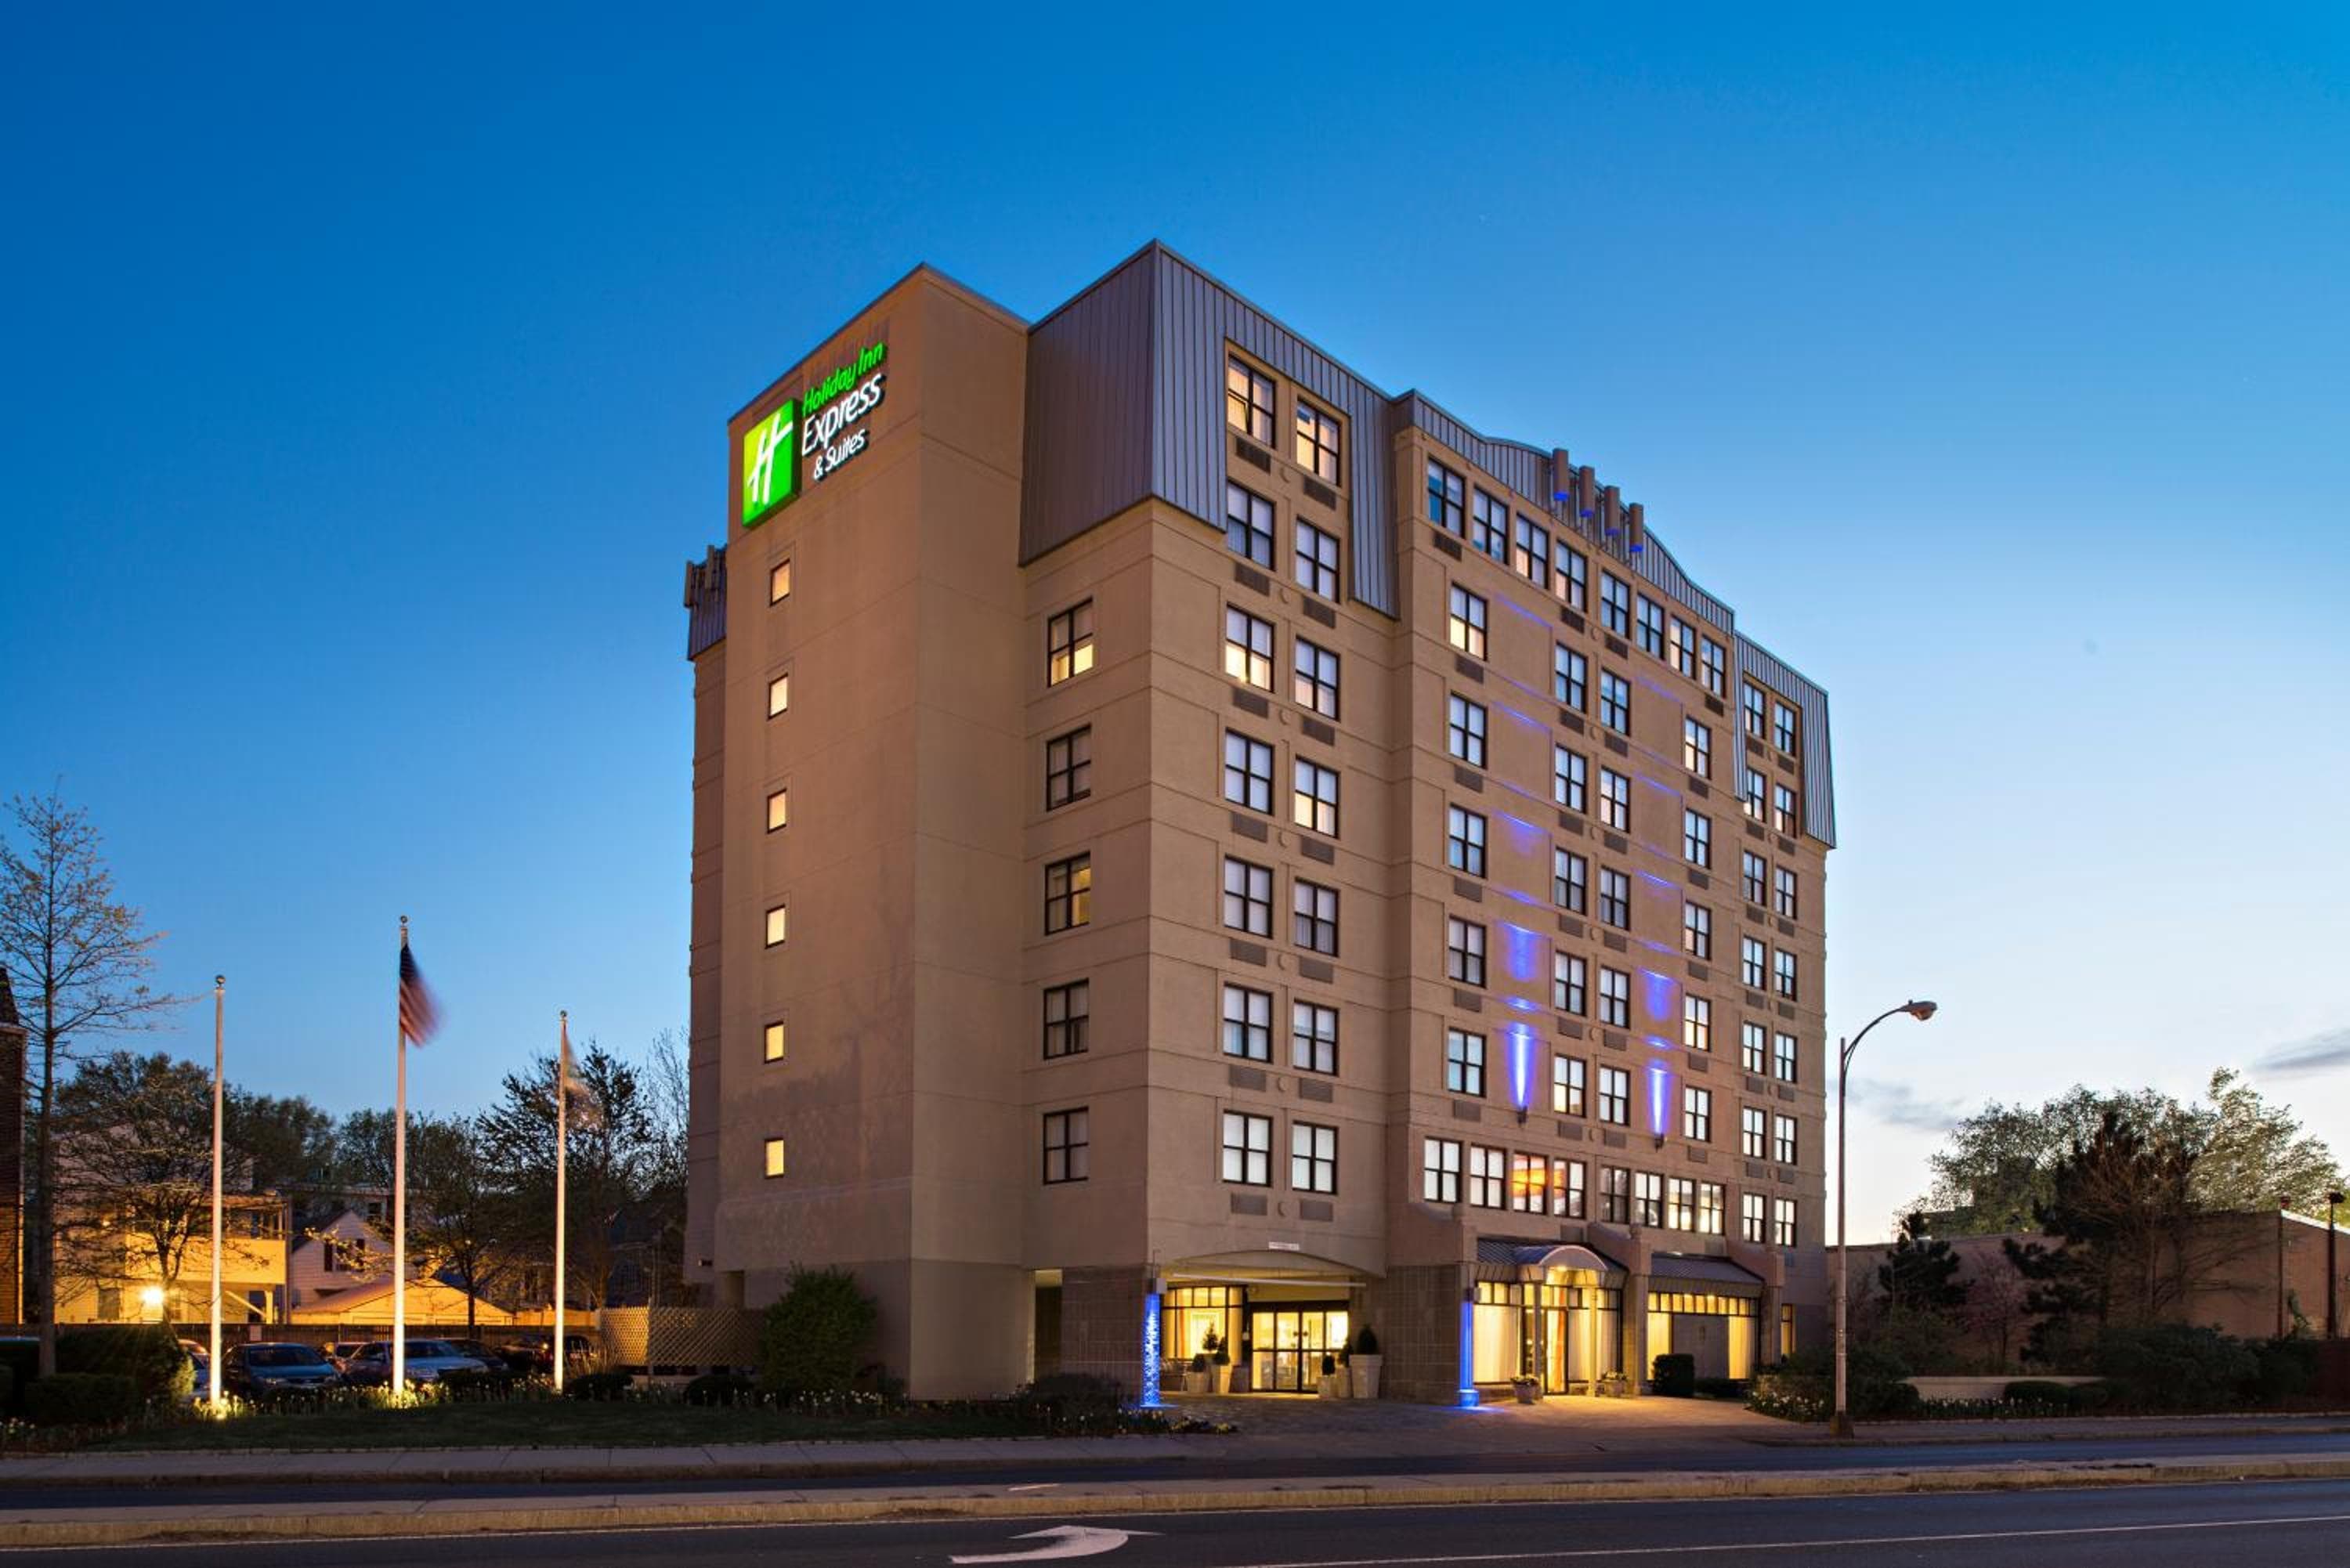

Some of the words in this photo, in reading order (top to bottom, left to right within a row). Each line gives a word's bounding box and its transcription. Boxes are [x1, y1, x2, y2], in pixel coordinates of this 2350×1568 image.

[801, 363, 857, 417] Holiday
[859, 342, 883, 376] Inn
[801, 373, 882, 457] Express
[813, 456, 823, 480] &
[824, 428, 866, 471] Suites
